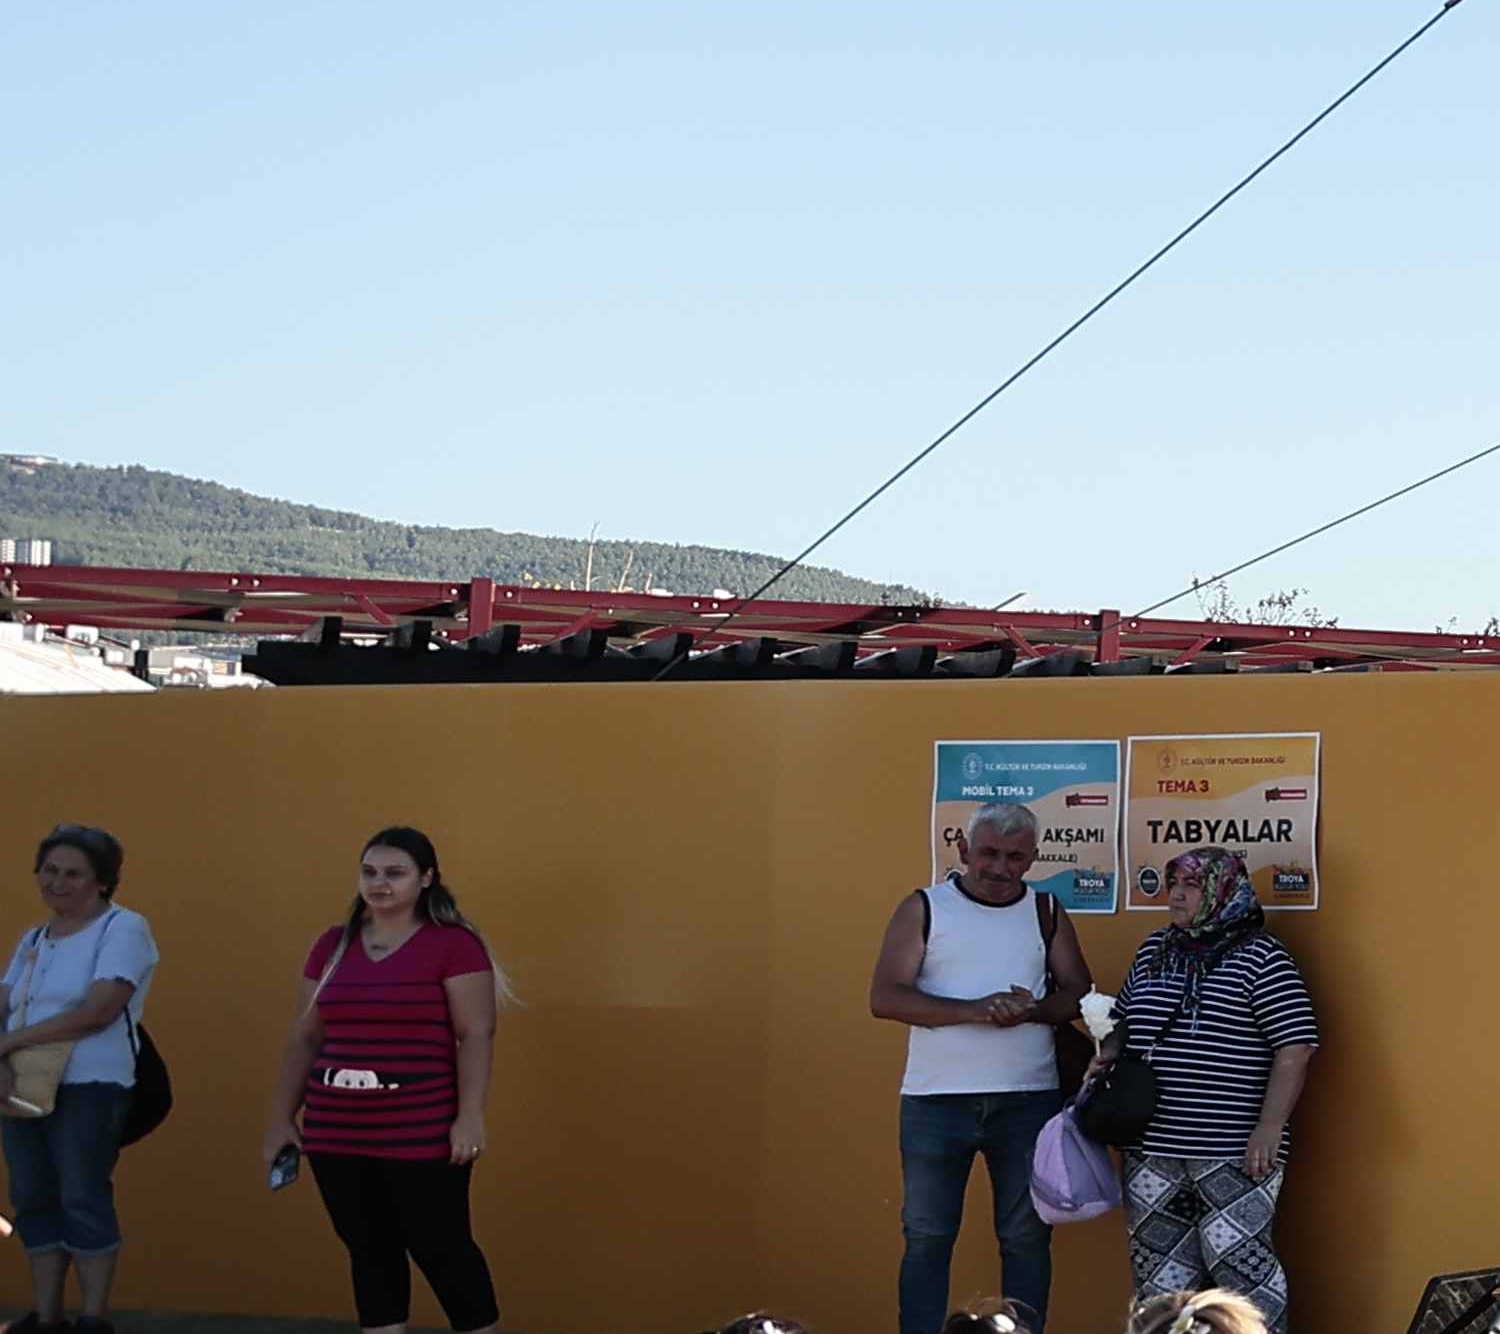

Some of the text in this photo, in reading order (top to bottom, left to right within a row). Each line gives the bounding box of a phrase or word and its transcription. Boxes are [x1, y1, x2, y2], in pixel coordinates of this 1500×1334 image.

[962, 783, 1034, 796] MOBİL TEMA 3
[1157, 779, 1210, 793] TEMA 3
[1042, 827, 1105, 848] AKŞAMI
[1147, 819, 1293, 843] TABYALAR
[1079, 878, 1105, 888] TROYA
[1279, 874, 1304, 883] TROYA
